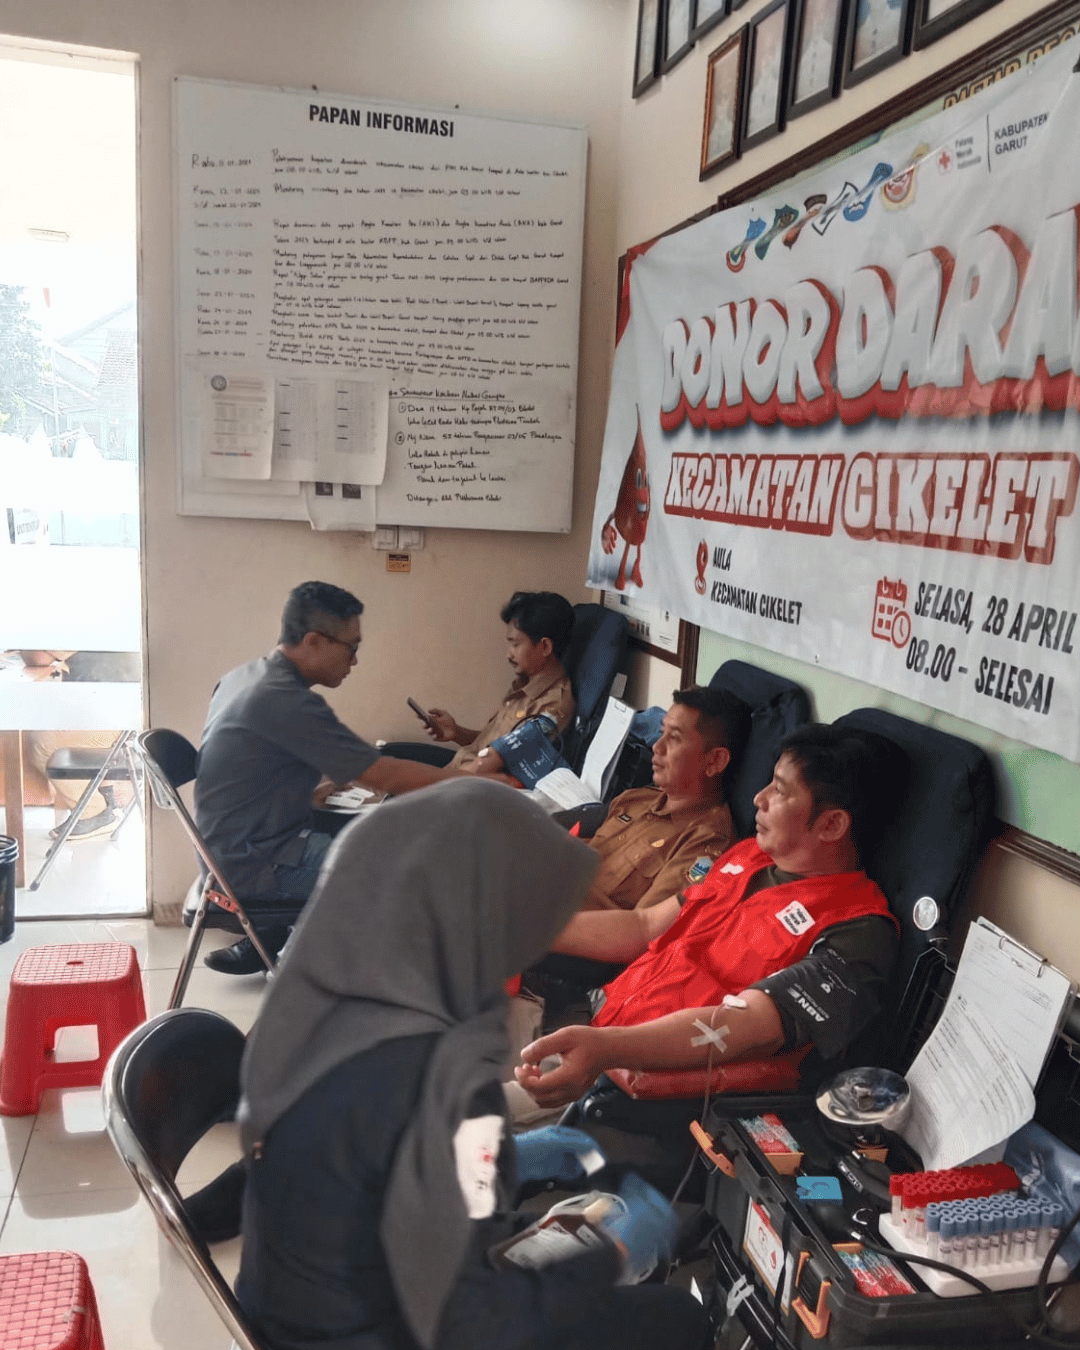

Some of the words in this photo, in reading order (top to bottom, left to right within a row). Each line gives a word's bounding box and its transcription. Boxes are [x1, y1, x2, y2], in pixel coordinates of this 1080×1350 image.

[308, 104, 361, 128] PAPAN
[366, 111, 455, 138] INFORMASI
[994, 111, 1050, 140] KABUPATEN
[994, 135, 1028, 155] GARUT
[660, 278, 841, 431] DONOR
[663, 452, 845, 536] KECAMATAN
[844, 452, 1080, 565] CIKELET
[712, 546, 732, 573] AULA
[710, 580, 757, 618] KECAMATAN
[759, 596, 803, 626] CIKELET
[914, 581, 975, 633] SELASA,
[981, 595, 1006, 635] 28
[1008, 603, 1078, 654] APRIL
[905, 637, 956, 683] 08.00
[974, 654, 1055, 716] SELESAI
